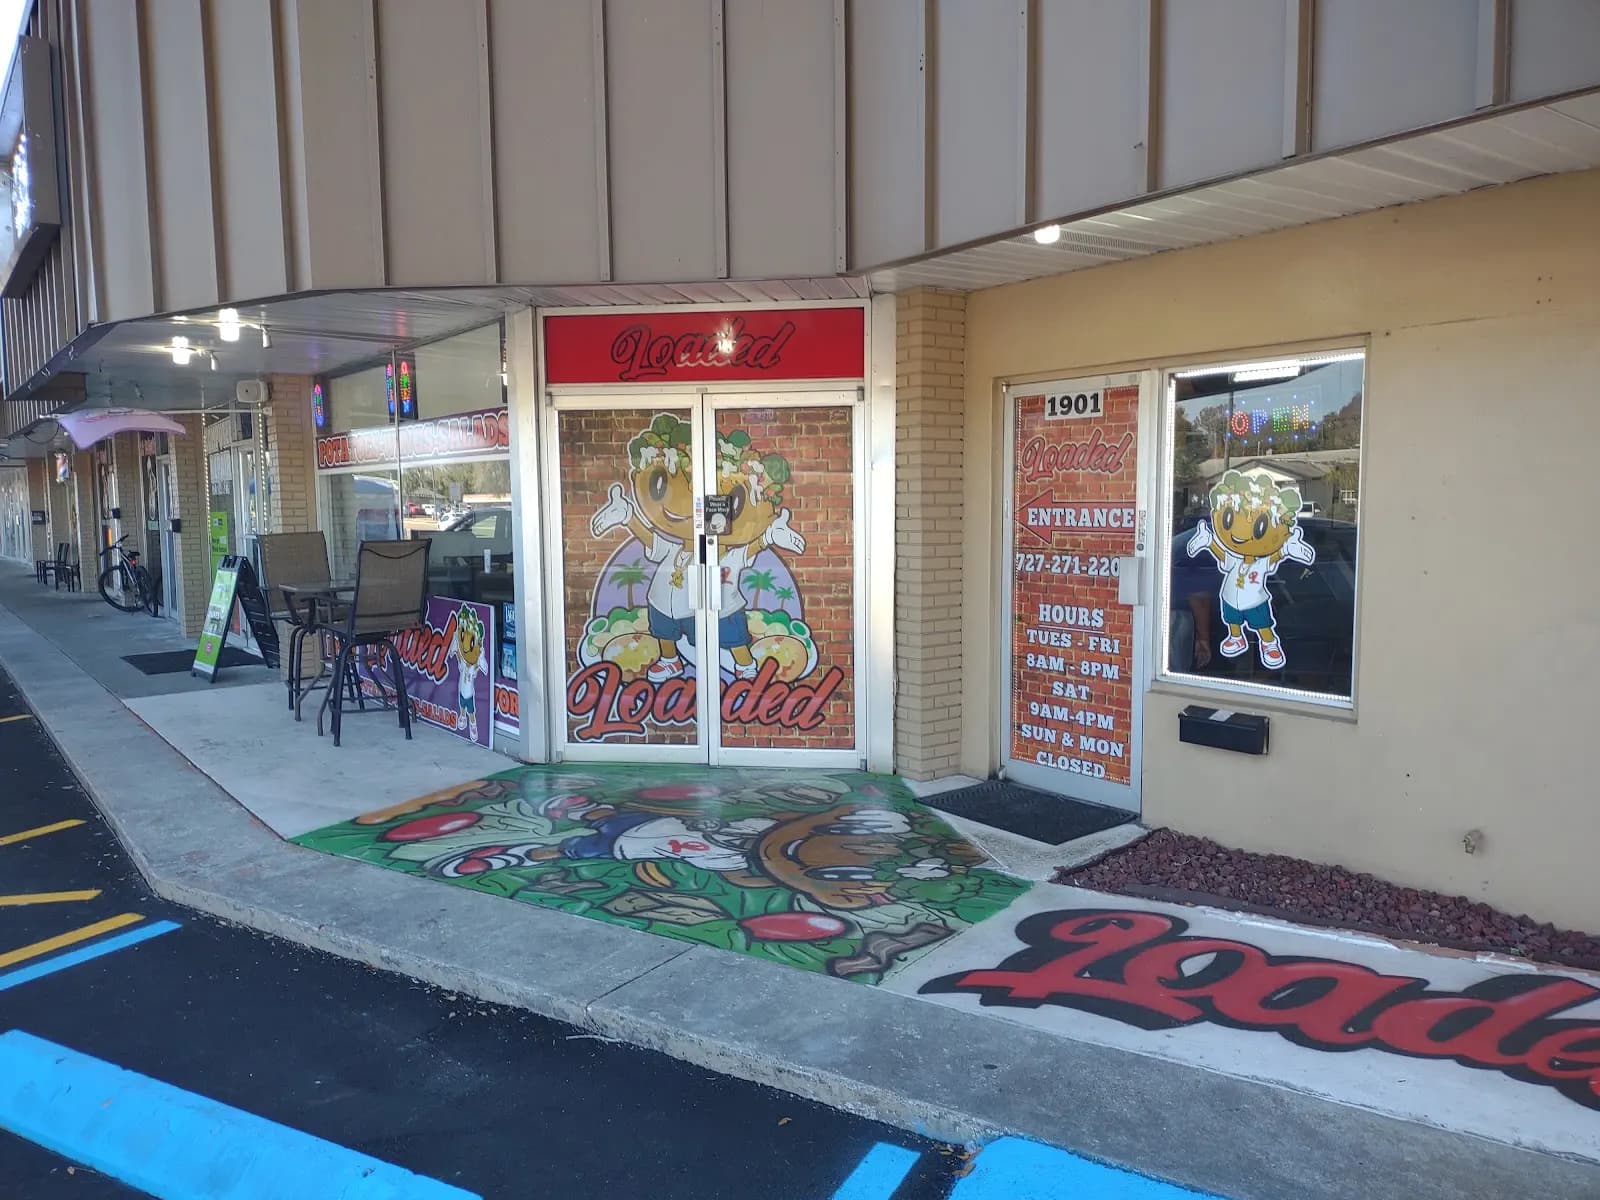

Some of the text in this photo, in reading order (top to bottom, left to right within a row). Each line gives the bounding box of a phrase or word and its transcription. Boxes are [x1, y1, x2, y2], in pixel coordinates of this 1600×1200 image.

[610, 316, 796, 381] Loaded
[1048, 392, 1101, 417] 1901
[1230, 404, 1311, 436] OPEN
[1022, 429, 1134, 483] Loaded
[1027, 507, 1135, 528] ENTRANCE
[1016, 553, 1120, 577] 727-271-220
[1038, 603, 1105, 628] HOURS
[1027, 628, 1072, 649] TUES
[1088, 636, 1120, 654] FRI
[1026, 652, 1065, 672] 8AM
[1080, 660, 1120, 680] 8PM
[1052, 681, 1090, 701] SAT
[1029, 701, 1115, 731] 9AM-4PM
[1021, 723, 1125, 758] SUN & MON
[1036, 750, 1106, 779] CLOSED
[918, 907, 1600, 1111] Loade
